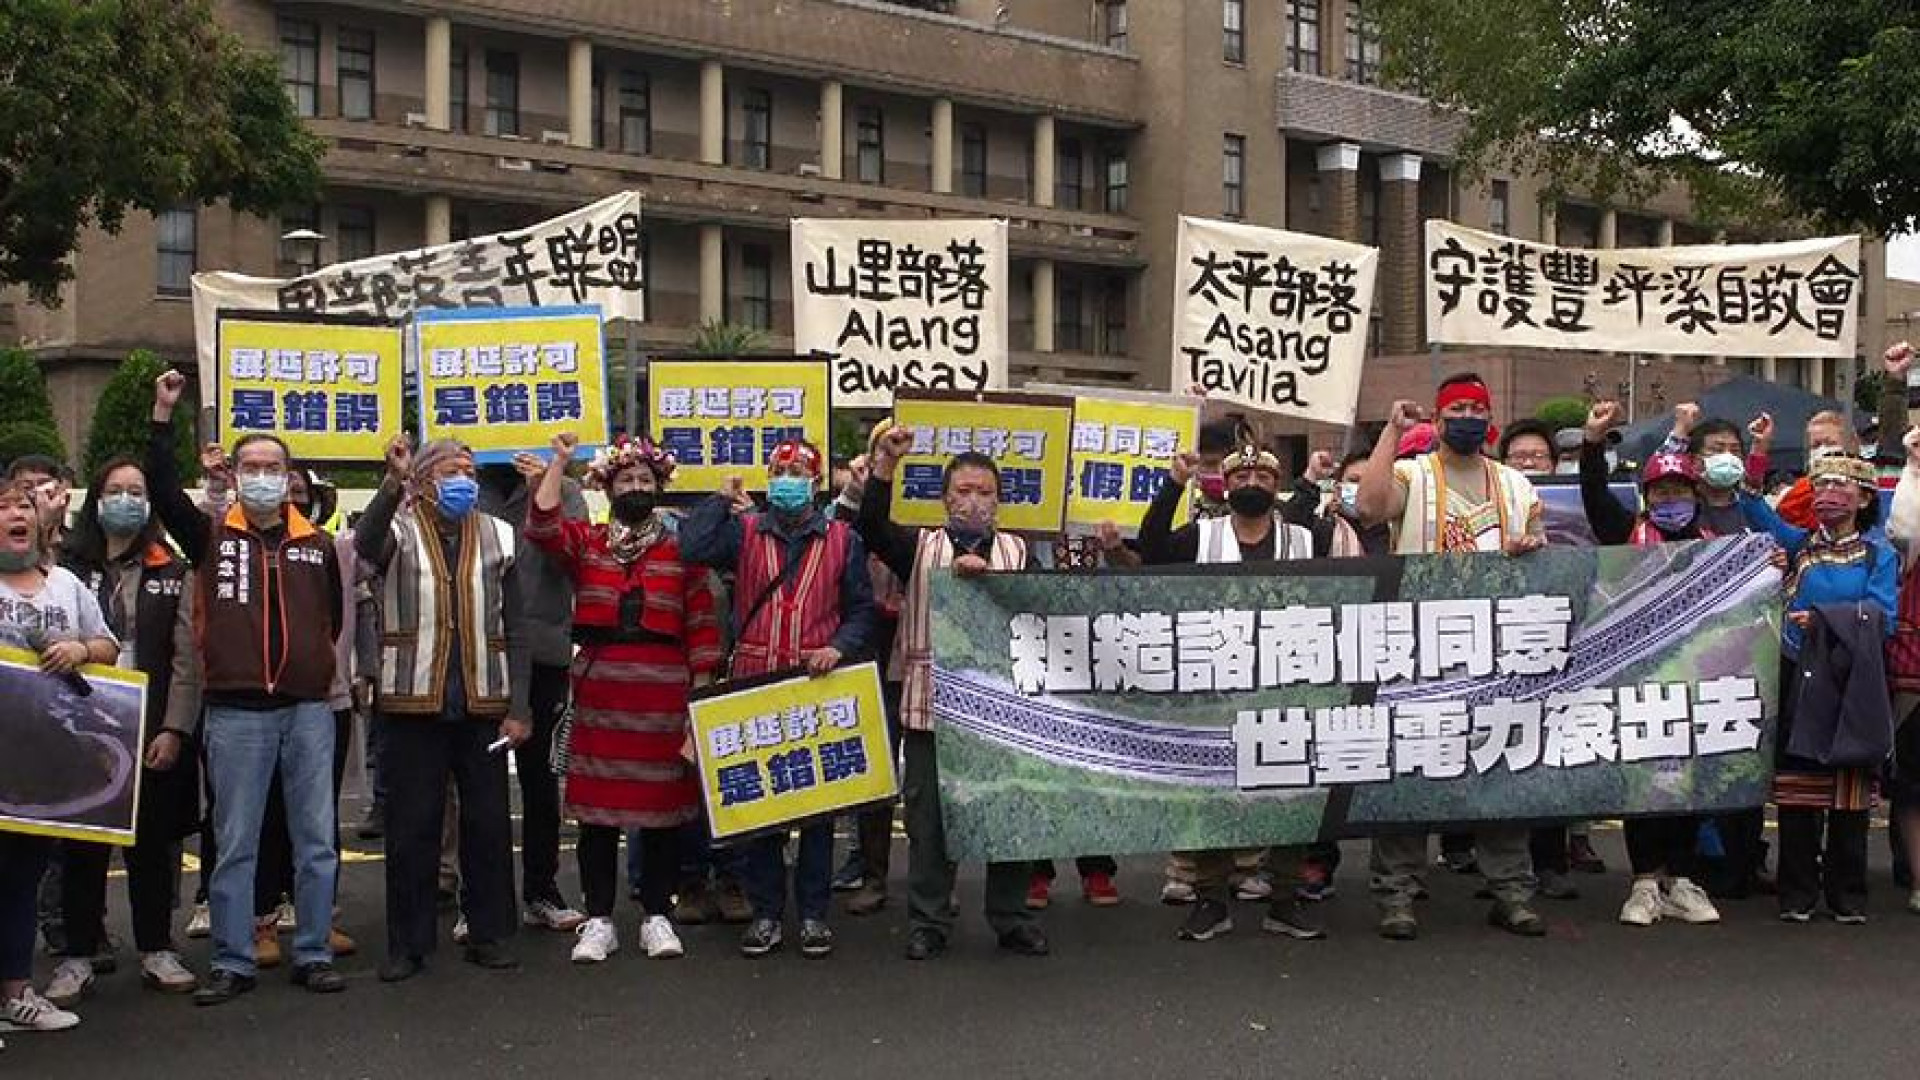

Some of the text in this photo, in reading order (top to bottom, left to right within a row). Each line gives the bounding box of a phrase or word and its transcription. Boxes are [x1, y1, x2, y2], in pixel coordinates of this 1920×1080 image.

[805, 238, 989, 310] 山里部落
[1188, 250, 1361, 333] 太平部落
[1430, 236, 1859, 340] 守護豐坪溪自救會
[430, 342, 579, 378] 展延許可
[837, 308, 979, 355] Alang
[1204, 312, 1332, 375] Asang
[231, 349, 380, 386] 展延許可
[1180, 346, 1307, 407] Tavila
[231, 389, 379, 433] 是錯誤
[434, 381, 582, 425] 是錯誤
[659, 387, 805, 419] 展延許可
[901, 464, 1042, 505] 是誤
[1067, 460, 1172, 502] 假的
[1009, 594, 1573, 696] 粗糙諮商假同意
[708, 697, 859, 761] 展延許可
[1232, 676, 1765, 789] 世豐電力滾出去
[717, 735, 868, 808] 是錯誤
